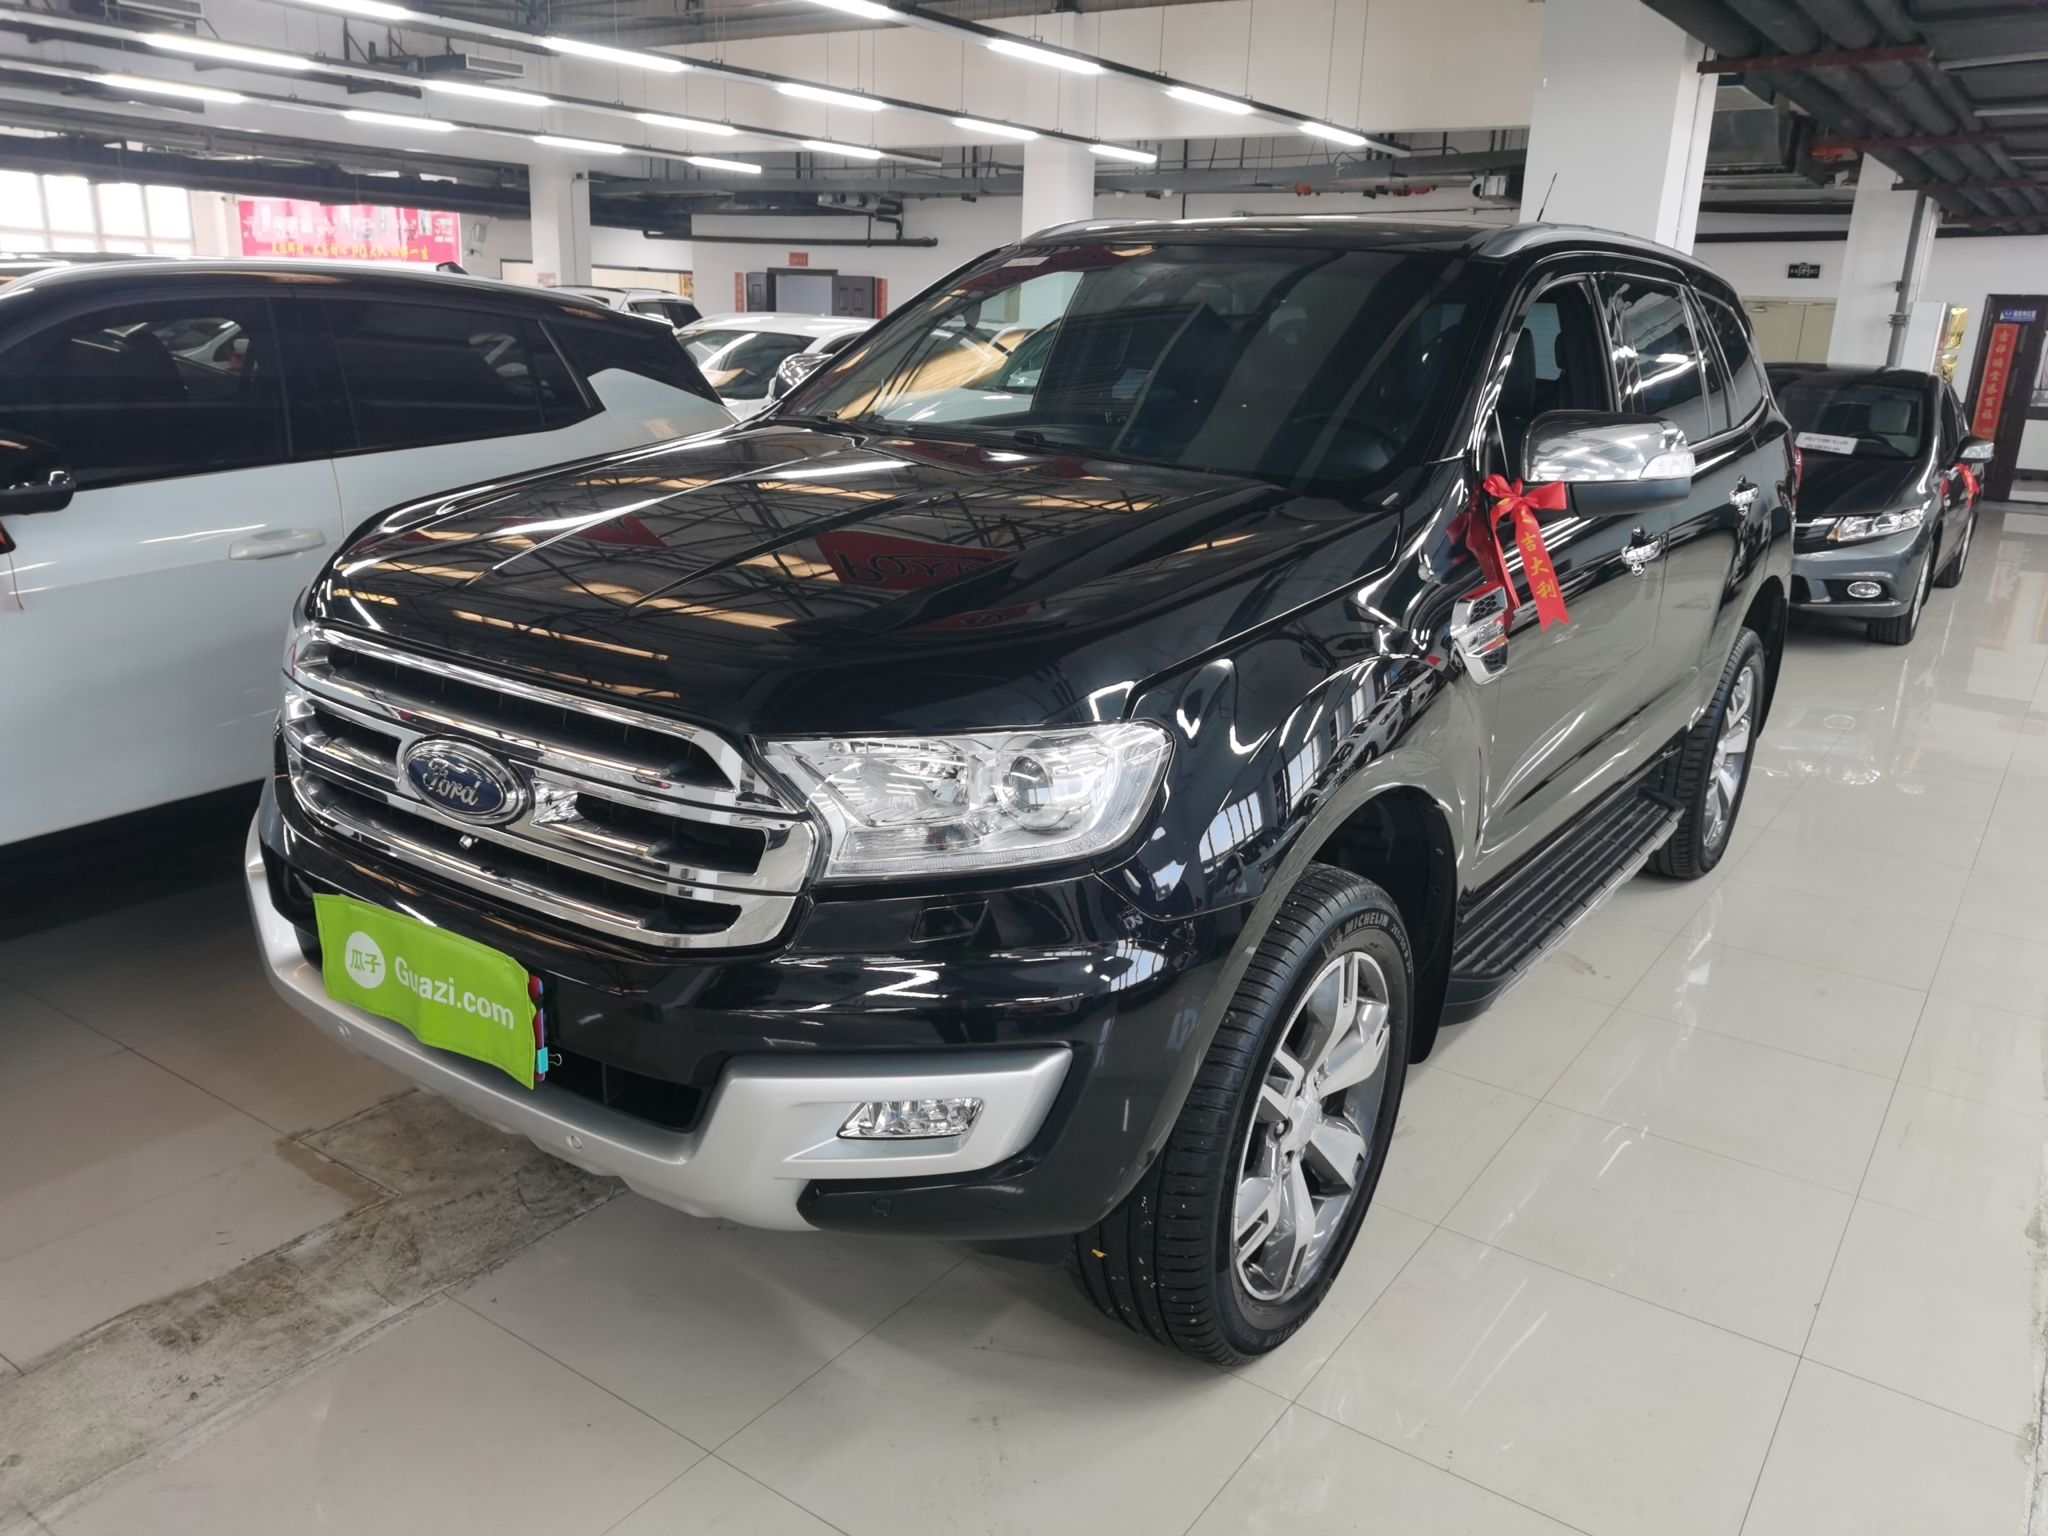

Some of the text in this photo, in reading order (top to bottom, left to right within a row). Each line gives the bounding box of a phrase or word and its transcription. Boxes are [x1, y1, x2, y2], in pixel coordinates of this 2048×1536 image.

[423, 758, 480, 806] Ford
[1345, 912, 1390, 935] MICHELIN
[350, 950, 381, 974] 瓜子
[395, 956, 515, 1030] Guazi.com
